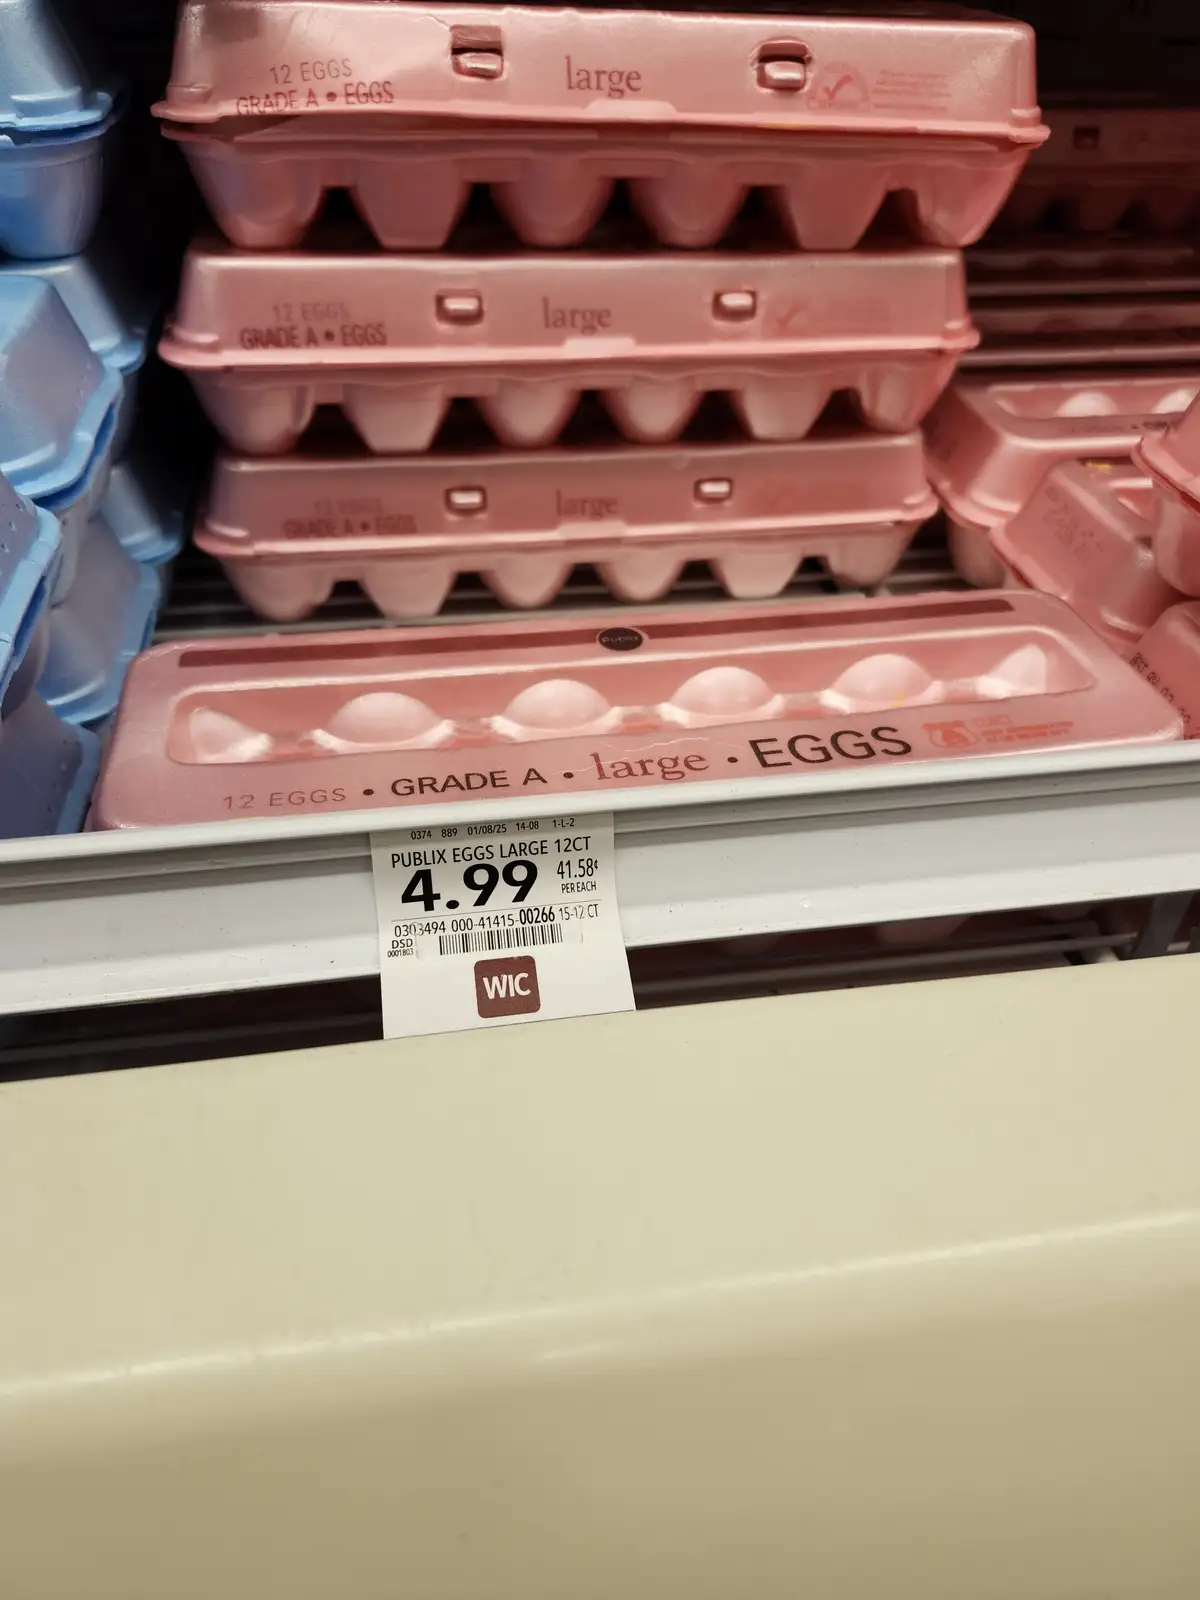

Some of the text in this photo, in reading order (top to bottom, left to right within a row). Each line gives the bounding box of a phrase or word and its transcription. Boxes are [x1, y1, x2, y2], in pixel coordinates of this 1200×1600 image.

[269, 58, 353, 85] 12 EGGS
[564, 55, 641, 99] large
[236, 80, 395, 115] GRADE A EGGS
[540, 295, 612, 336] large
[240, 322, 388, 350] GRADE A EGGS
[555, 488, 618, 520] large
[223, 726, 912, 811] 12 EGGS GRADE A large EGGS
[411, 818, 575, 840] 0374 889 01/08/25 14-08 1-L-2
[391, 836, 592, 868] PUBLIX EGGS LARGE 12CT
[401, 860, 538, 912] 4.99
[561, 881, 597, 894] PER EACH
[394, 920, 446, 938] 0303494
[451, 906, 555, 933] 000-41415-00266
[587, 903, 599, 918] CT
[387, 948, 414, 958] 0001803
[391, 938, 413, 950] DSD
[482, 972, 532, 1000] WIC
